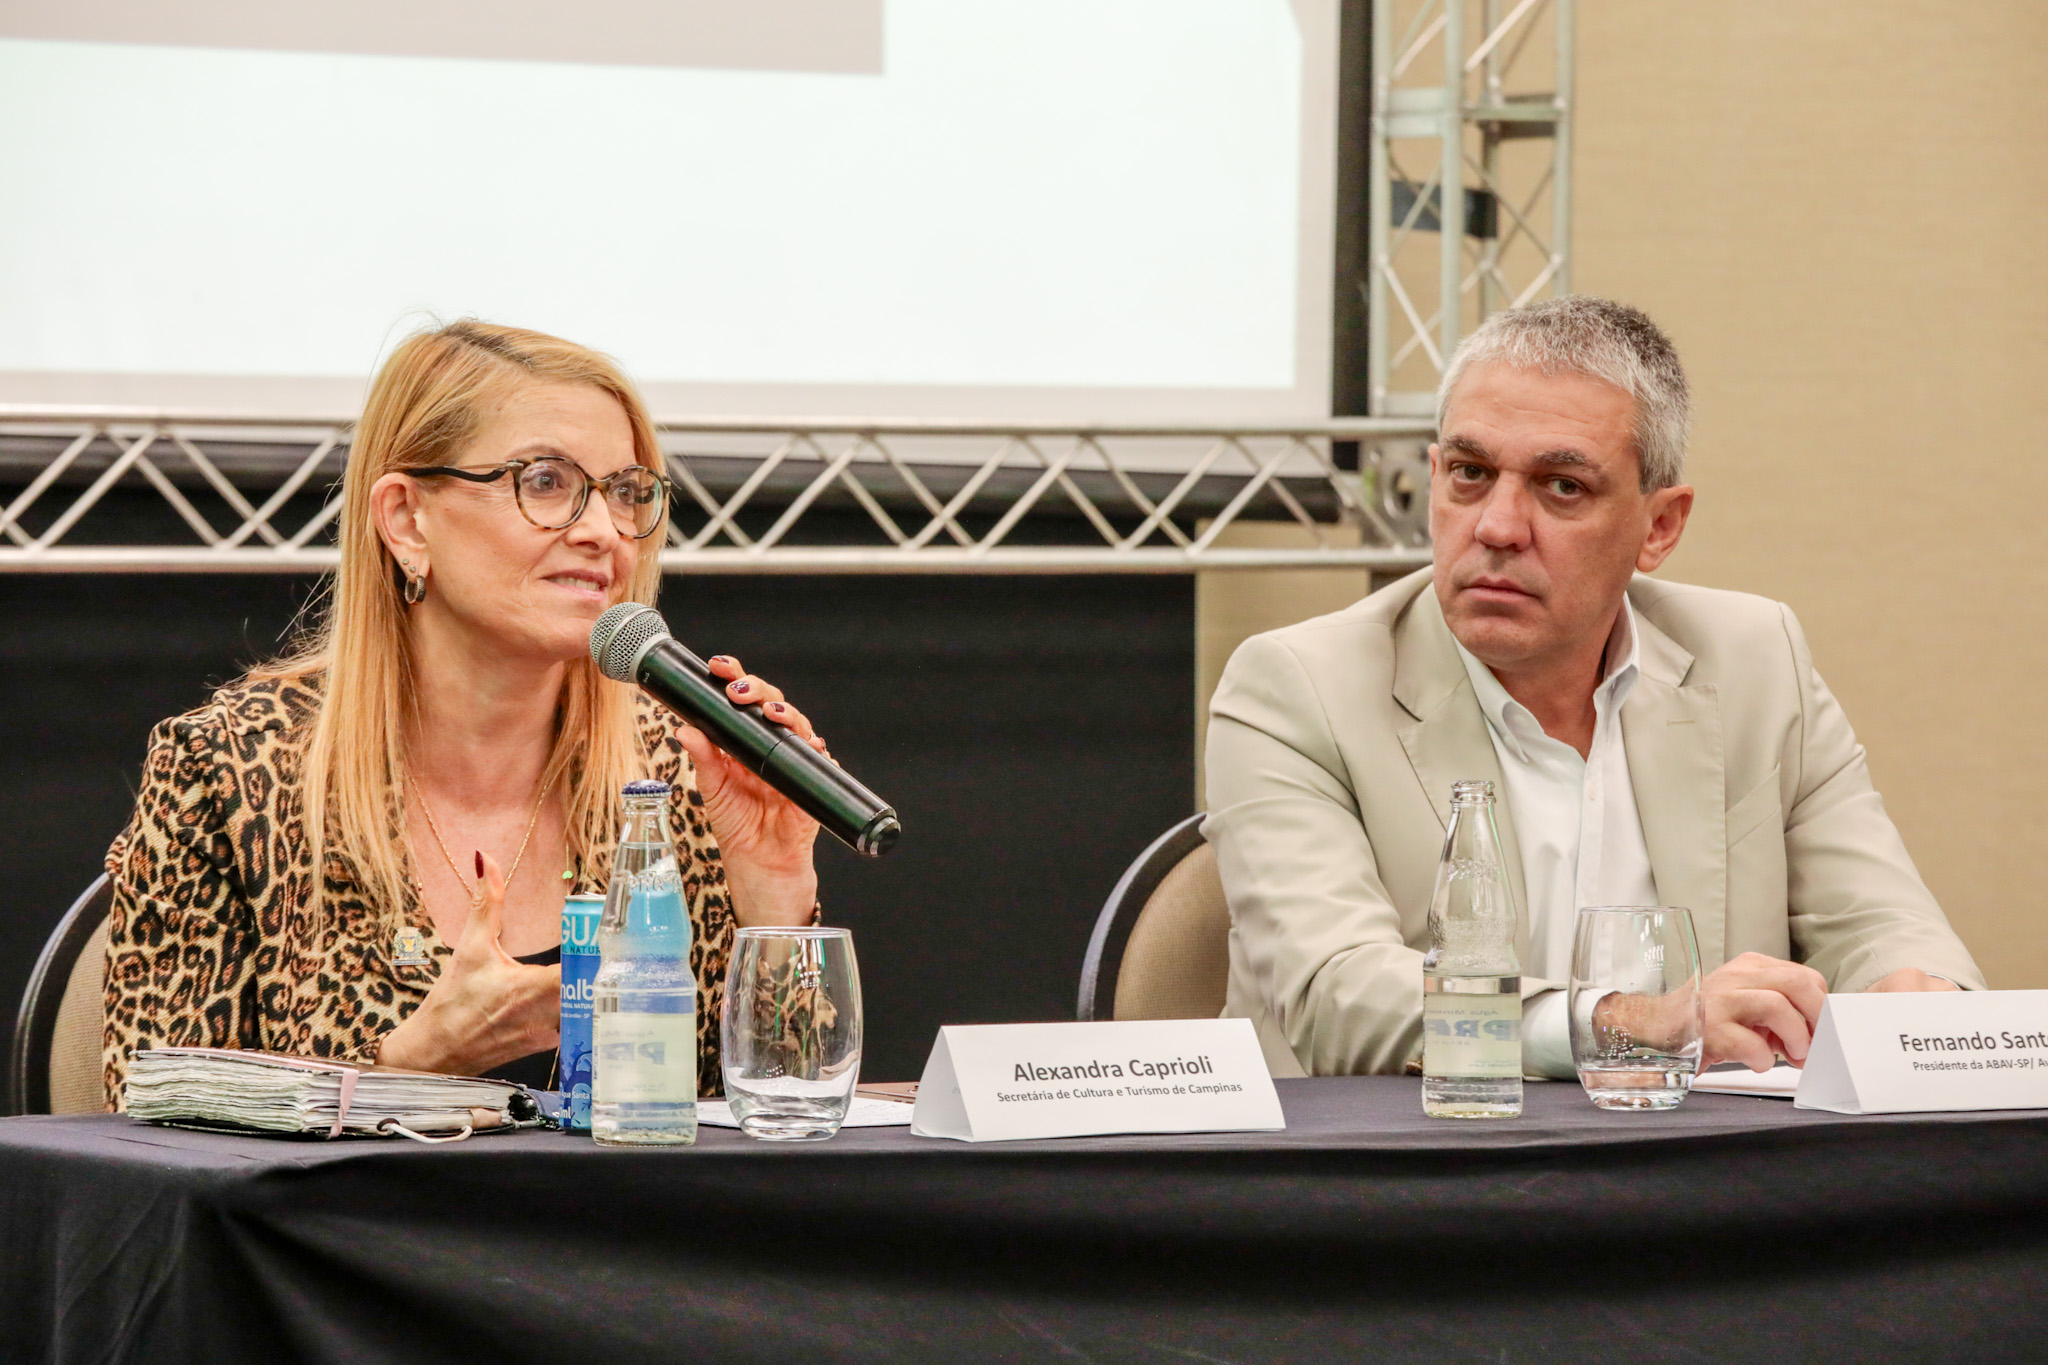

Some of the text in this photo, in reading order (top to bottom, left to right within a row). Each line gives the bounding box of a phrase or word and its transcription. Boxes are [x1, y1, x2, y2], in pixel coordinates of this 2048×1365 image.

[1899, 1031, 2048, 1052] Fernando Sant
[1013, 1055, 1214, 1083] Alexandra Caprioli
[1912, 1061, 1969, 1071] Presidente
[1970, 1058, 1984, 1070] da
[571, 1090, 590, 1099] Santa
[997, 1081, 1243, 1103] Secretária de Cultura e Turismo de Campinas
